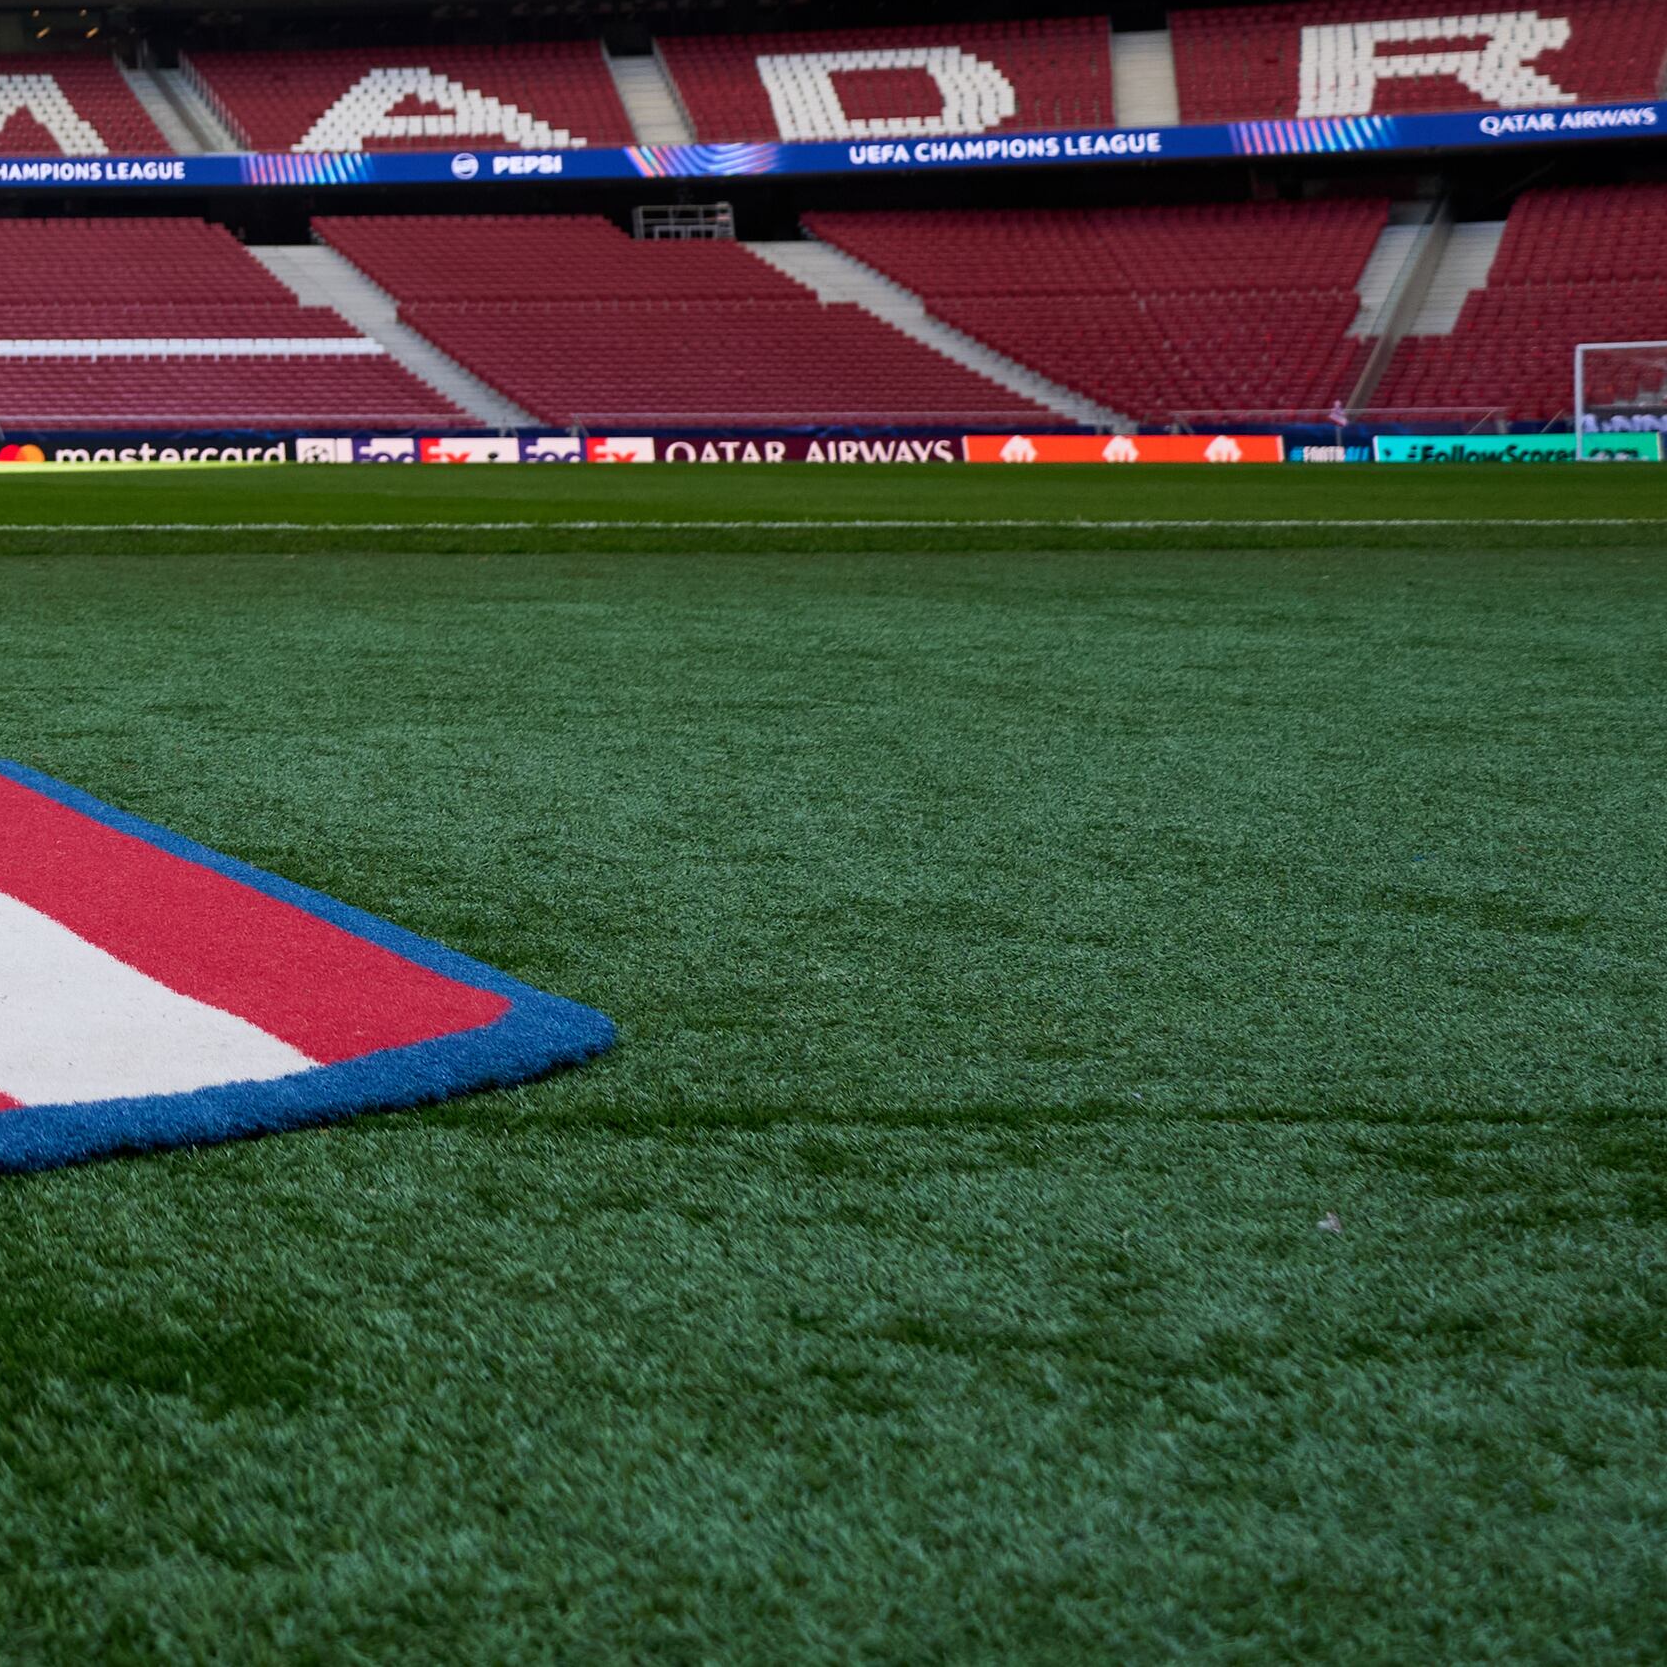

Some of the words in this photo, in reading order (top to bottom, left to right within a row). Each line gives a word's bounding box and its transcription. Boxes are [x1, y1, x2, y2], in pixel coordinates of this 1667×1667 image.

[1479, 113, 1557, 137] QATAR
[1559, 107, 1658, 130] AIRWAYS
[848, 144, 911, 165] UEFA
[913, 136, 1060, 162] CHAMPIONS
[1063, 132, 1162, 156] LEAGUE
[105, 161, 186, 180] LEAGUE
[492, 154, 563, 175] PEPSI
[55, 442, 286, 463] mastercard
[665, 441, 787, 463] QATAR
[804, 440, 955, 463] AIRWAYS
